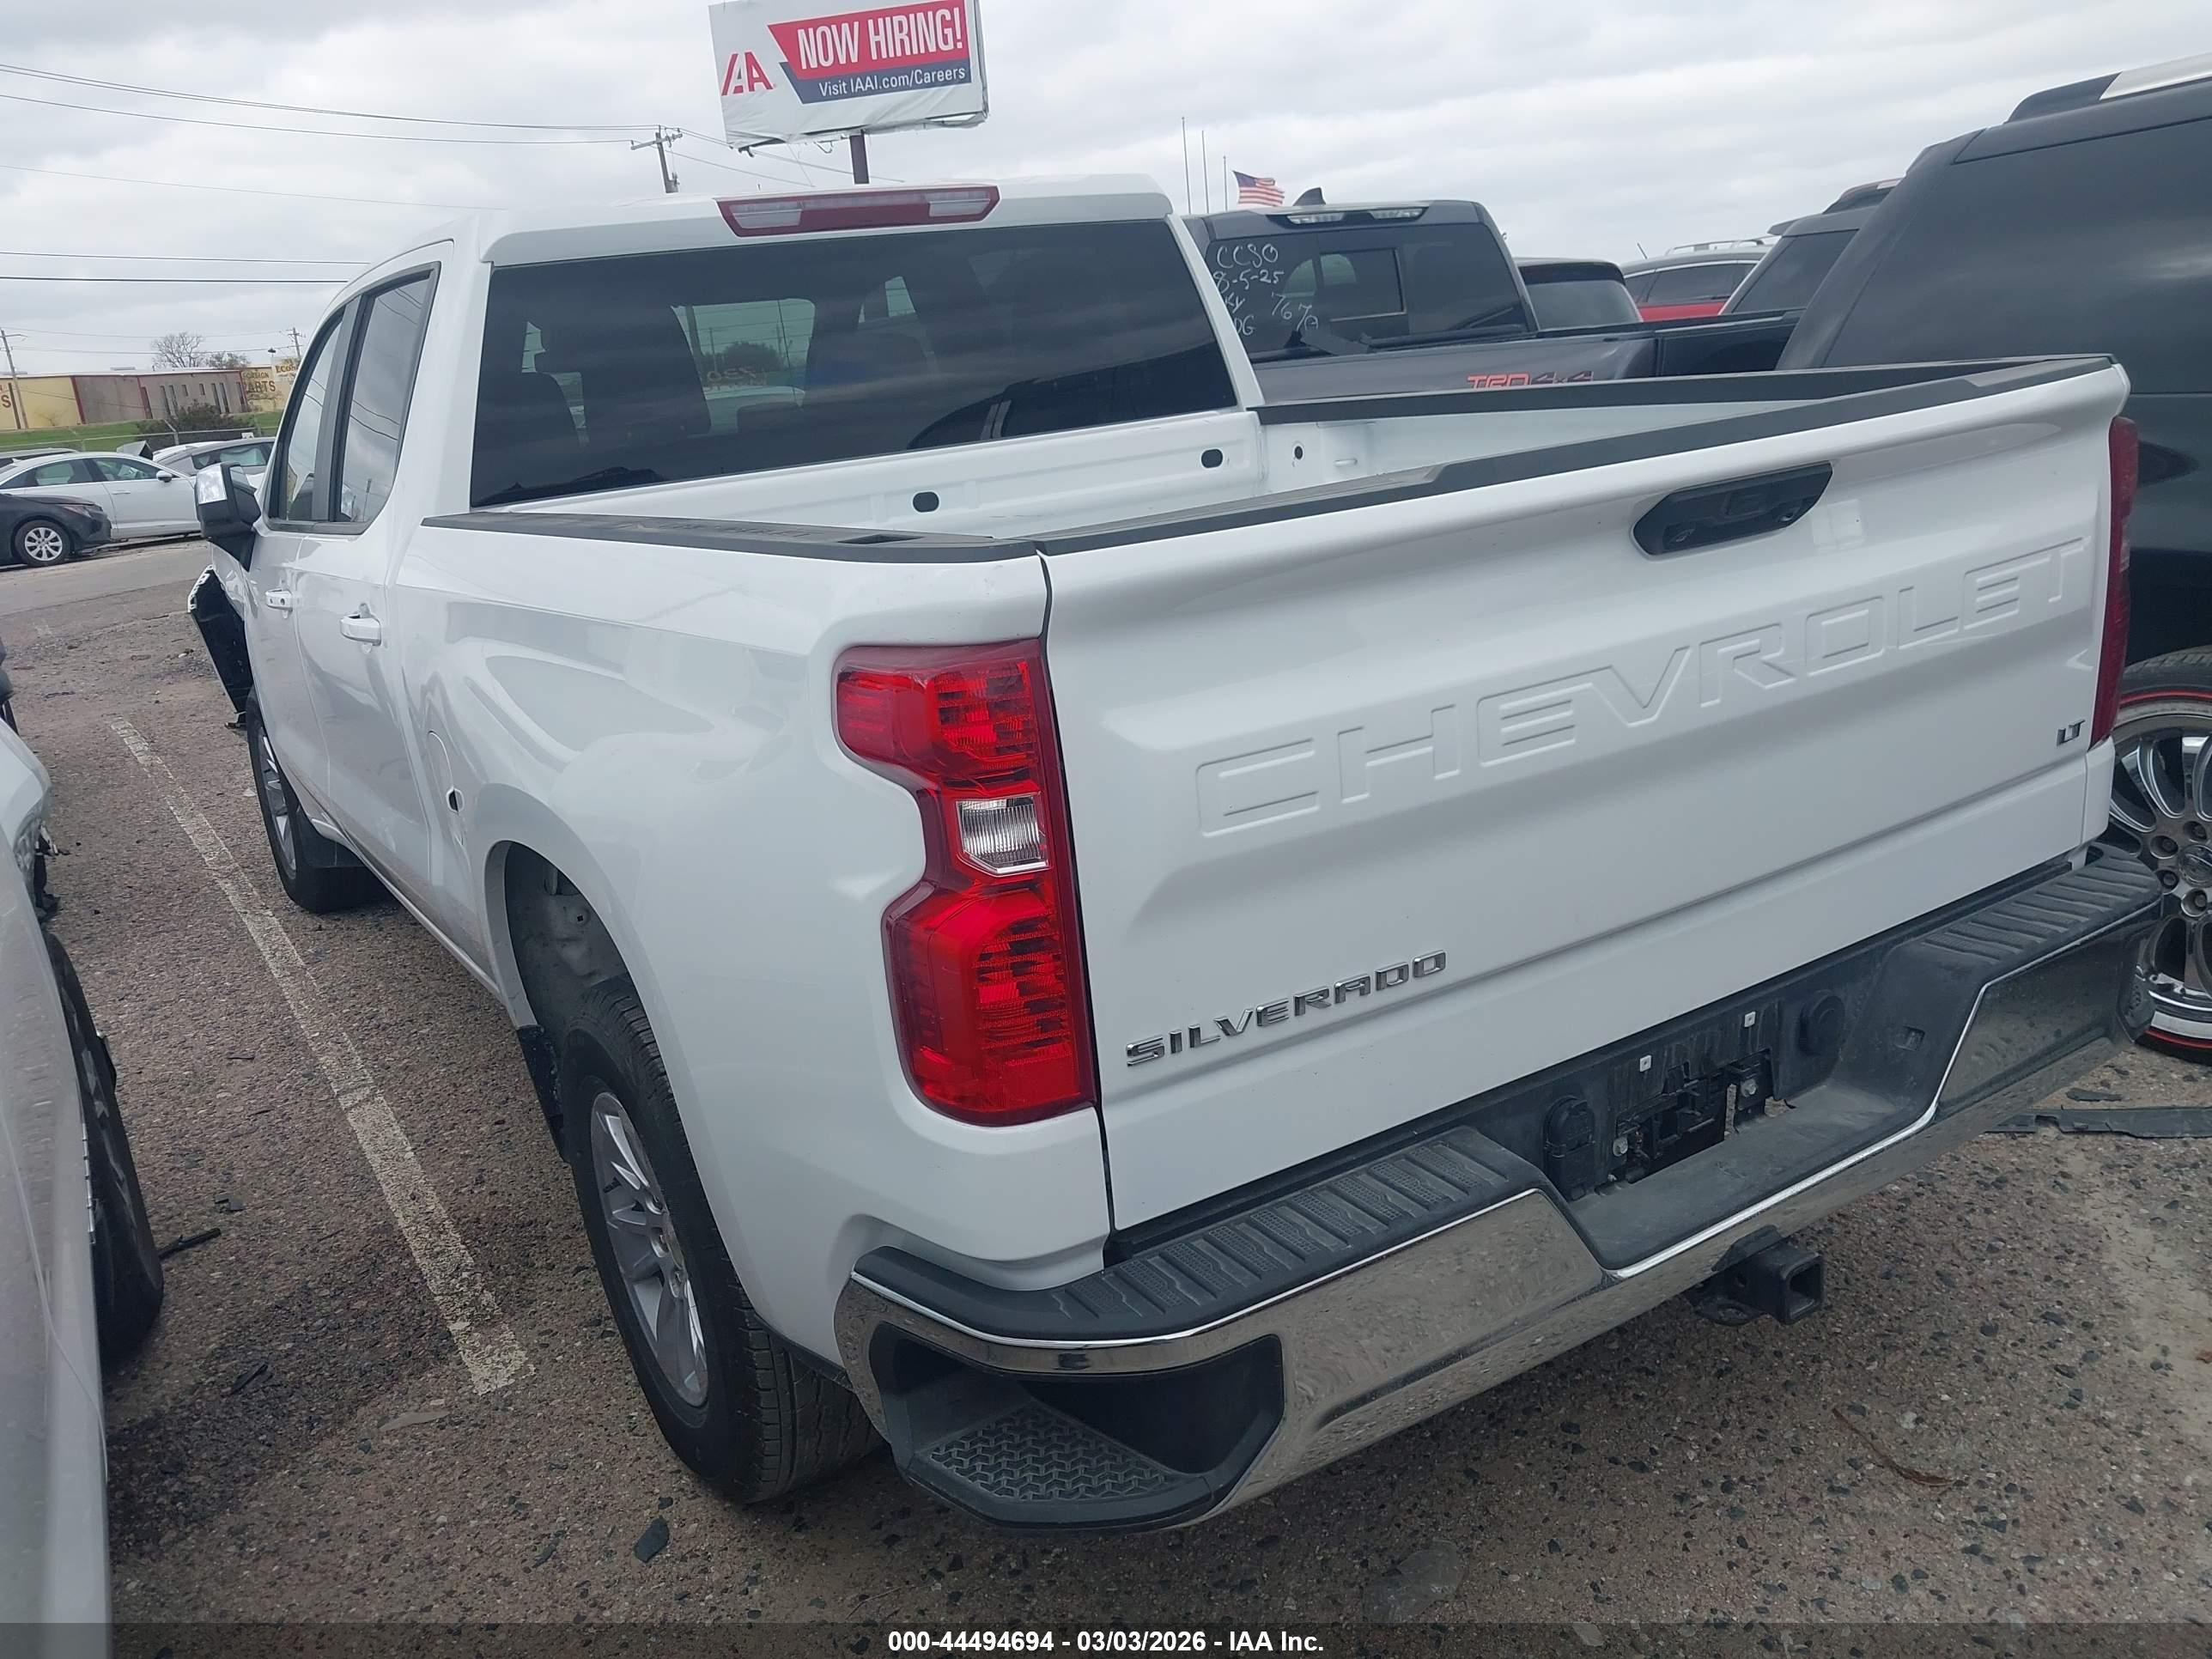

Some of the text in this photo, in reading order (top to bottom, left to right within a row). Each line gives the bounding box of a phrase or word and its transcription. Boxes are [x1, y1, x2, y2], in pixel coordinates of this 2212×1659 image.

[797, 7, 963, 70] NOW HIRING!
[818, 67, 966, 97] Visit IAAI.com/Careers
[1196, 537, 2092, 837] CHEVROLET
[2057, 720, 2086, 747] LT
[1126, 949, 1447, 1067] SILVERADO
